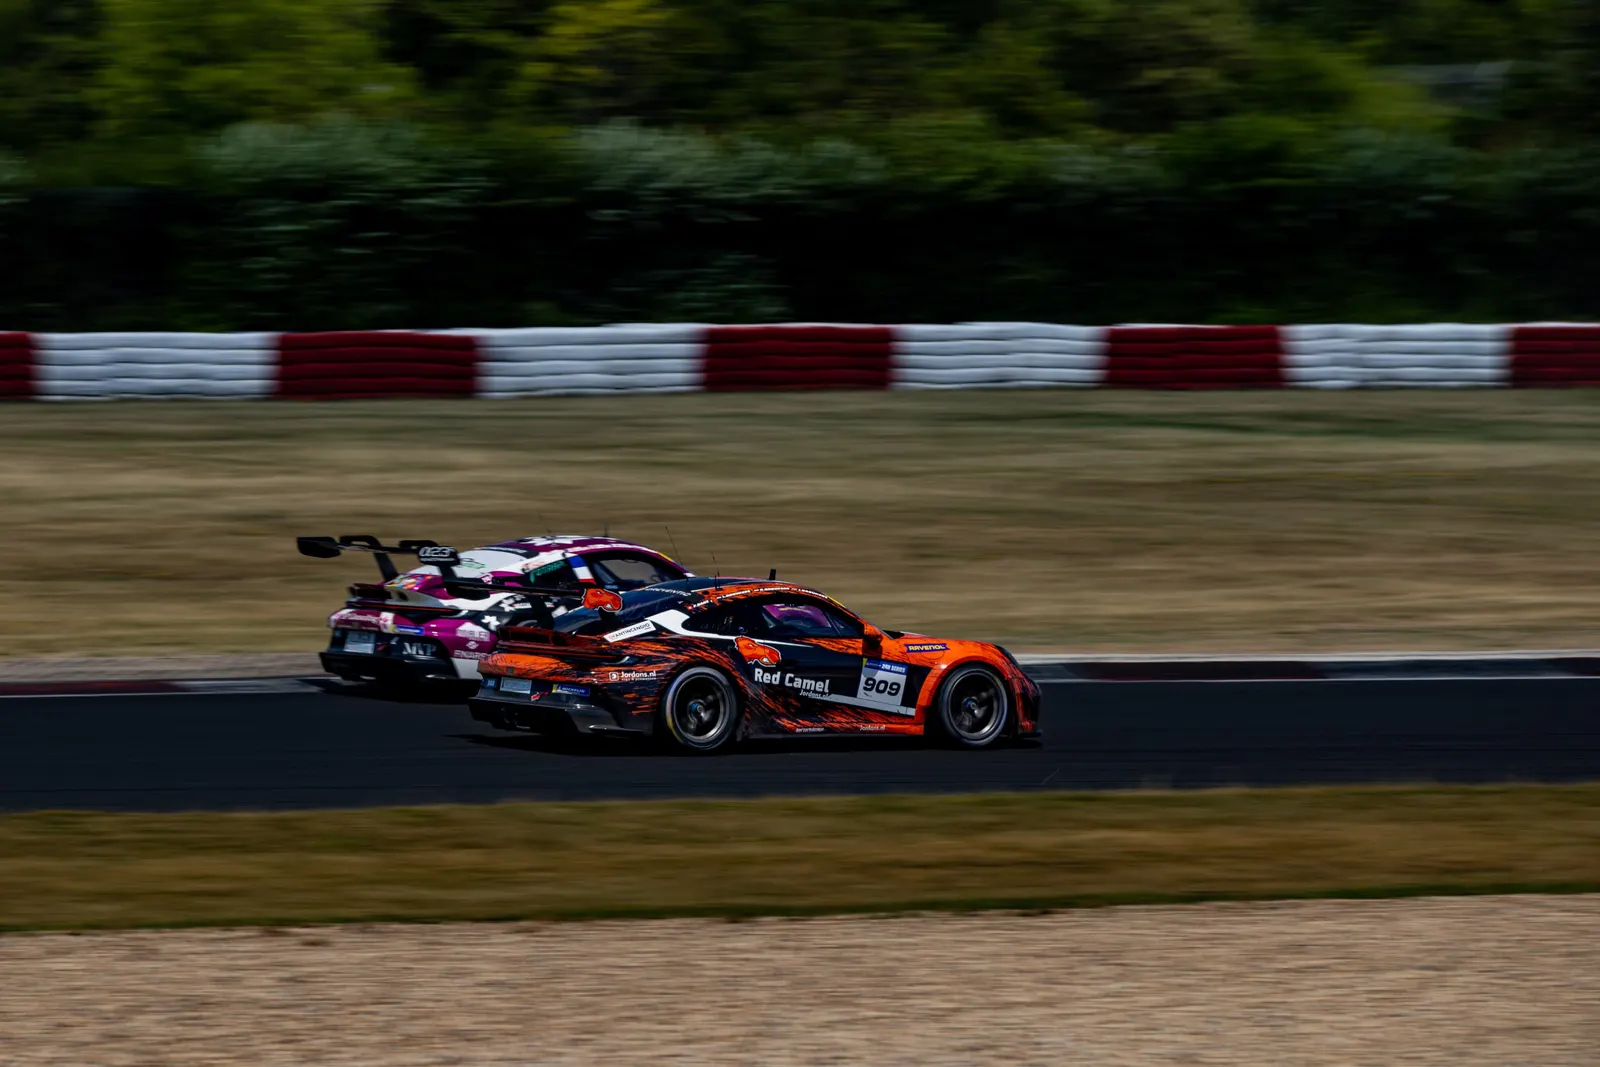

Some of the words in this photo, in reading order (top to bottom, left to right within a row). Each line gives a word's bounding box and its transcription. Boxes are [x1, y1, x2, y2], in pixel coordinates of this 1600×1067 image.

[754, 667, 781, 685] Red
[784, 673, 830, 693] Camel
[863, 677, 901, 696] 909
